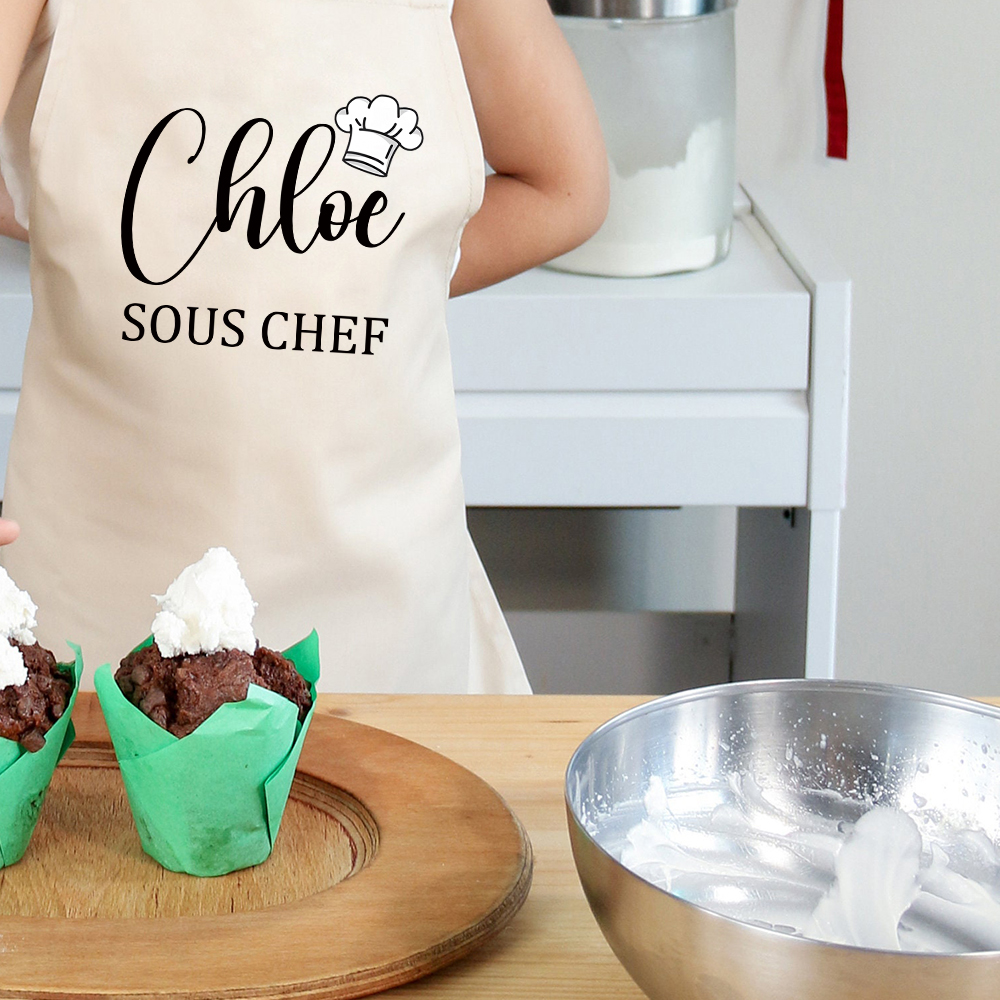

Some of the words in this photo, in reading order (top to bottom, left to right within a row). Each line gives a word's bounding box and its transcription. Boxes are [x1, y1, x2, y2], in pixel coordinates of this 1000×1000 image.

[120, 107, 406, 286] Chloe
[121, 302, 246, 348] SOUS
[261, 311, 390, 356] CHEF
